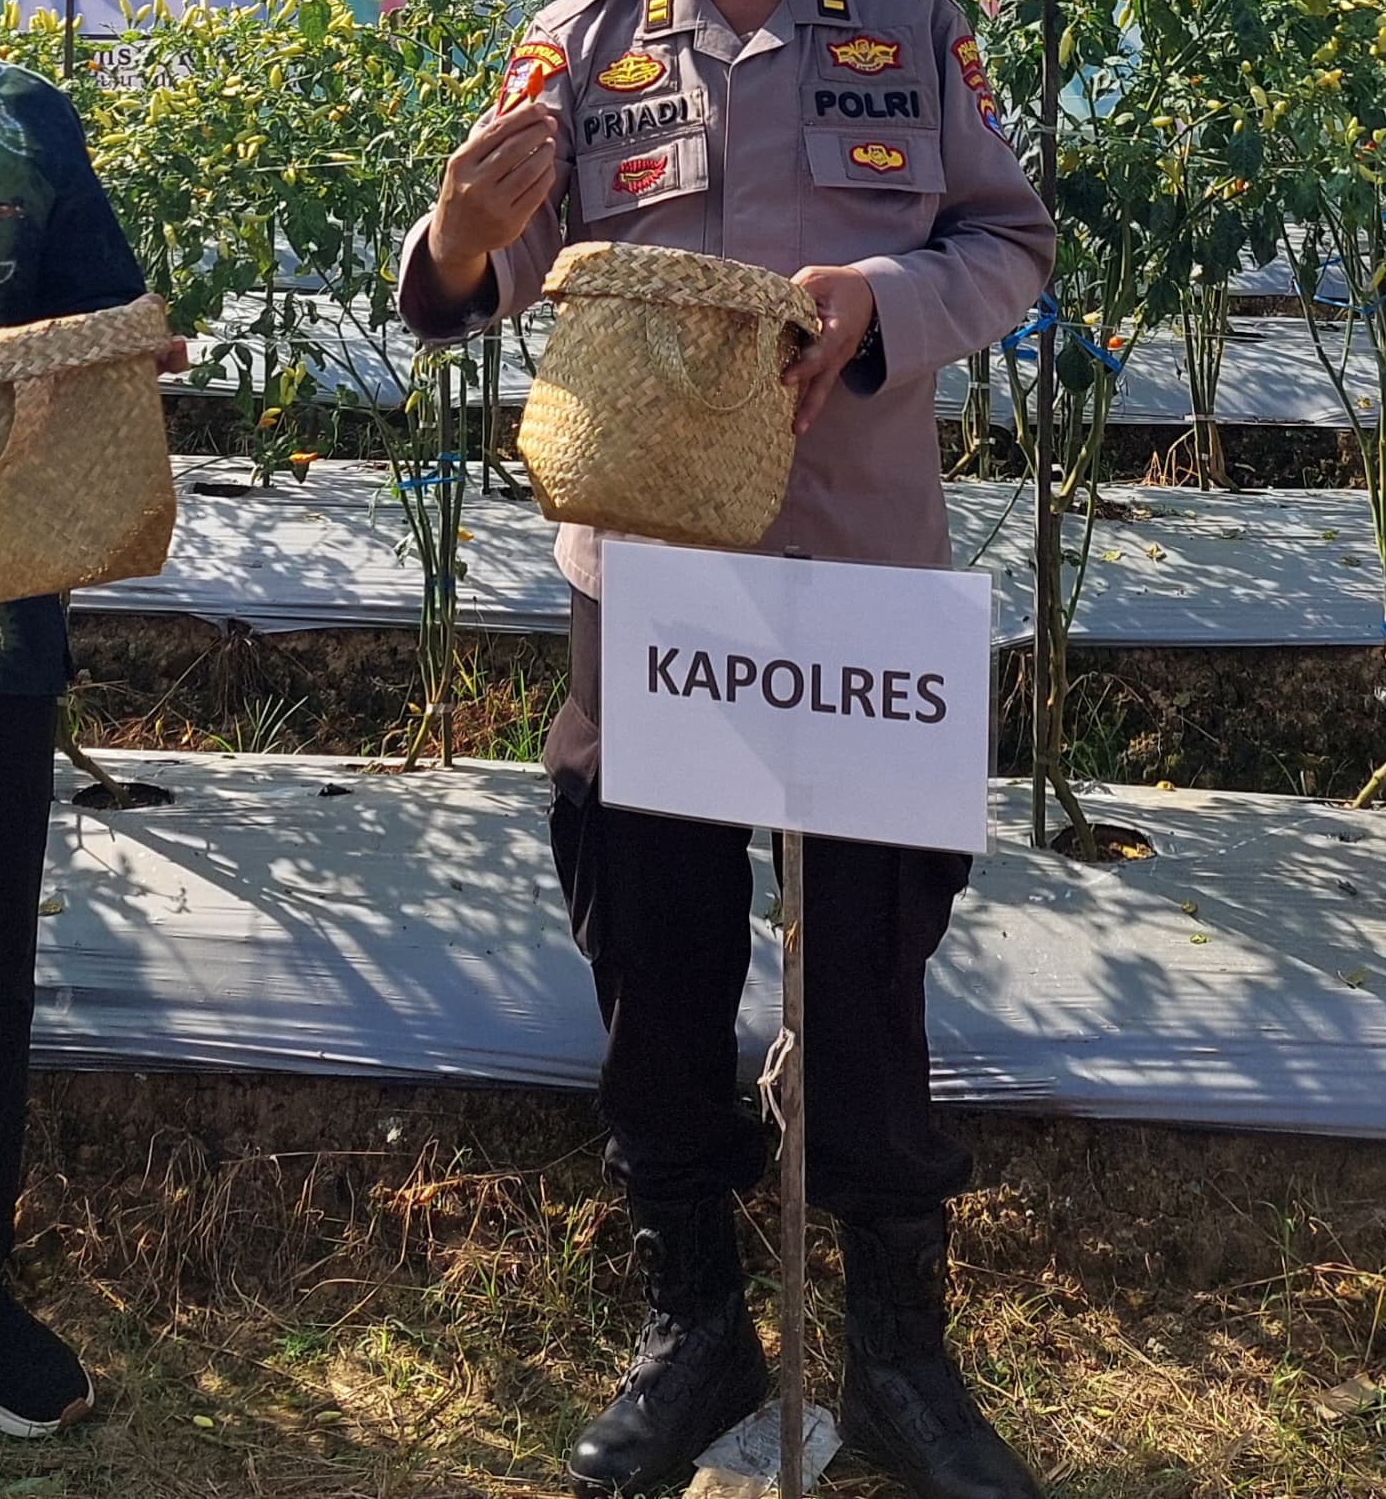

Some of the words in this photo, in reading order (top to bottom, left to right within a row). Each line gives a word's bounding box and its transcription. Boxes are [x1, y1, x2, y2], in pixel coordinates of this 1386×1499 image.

[583, 96, 689, 146] PRIADI
[814, 89, 920, 118] POLRI
[648, 645, 947, 724] KAPOLRES
